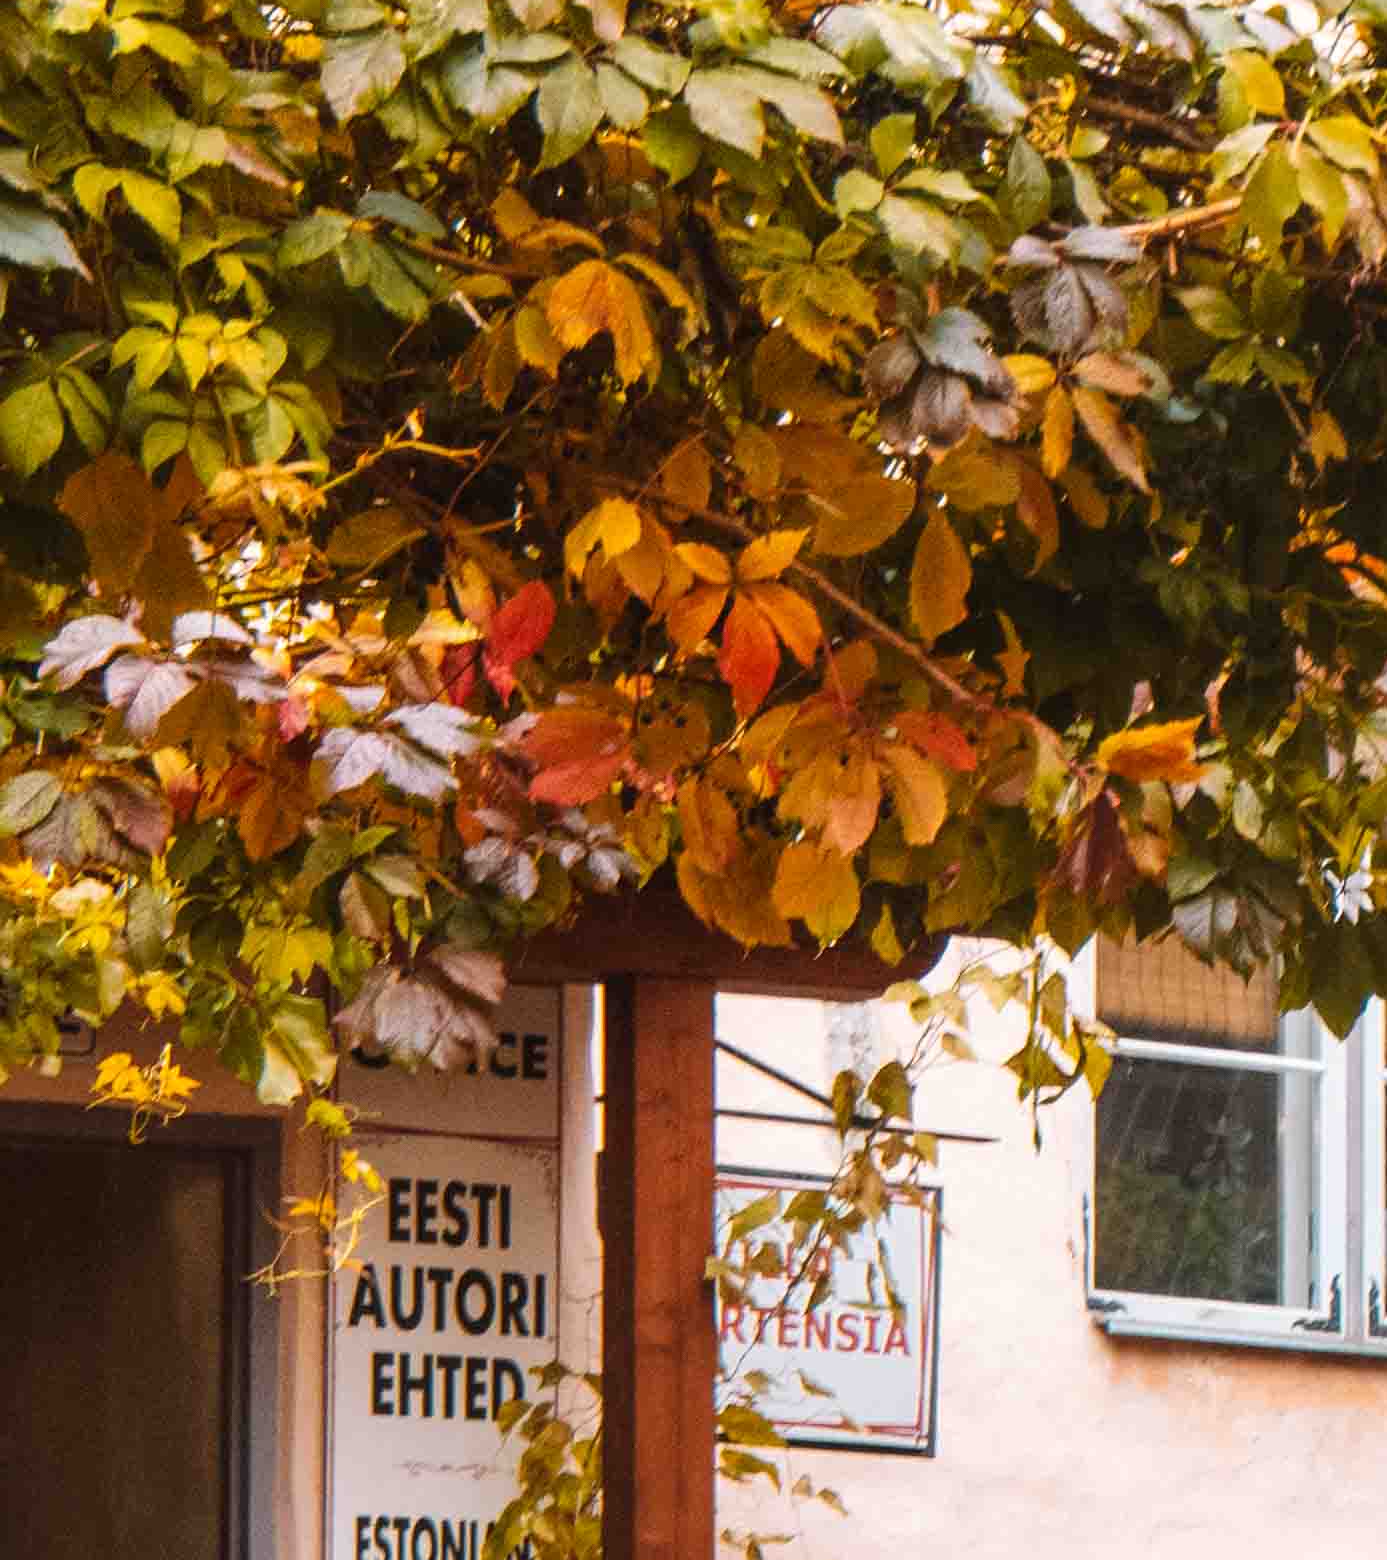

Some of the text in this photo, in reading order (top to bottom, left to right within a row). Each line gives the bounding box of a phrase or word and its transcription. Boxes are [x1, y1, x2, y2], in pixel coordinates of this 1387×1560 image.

[389, 1178, 512, 1250] EESTI
[348, 1264, 547, 1338] AUTORI
[720, 1303, 911, 1356] RTENSIA
[371, 1352, 526, 1422] EHTED
